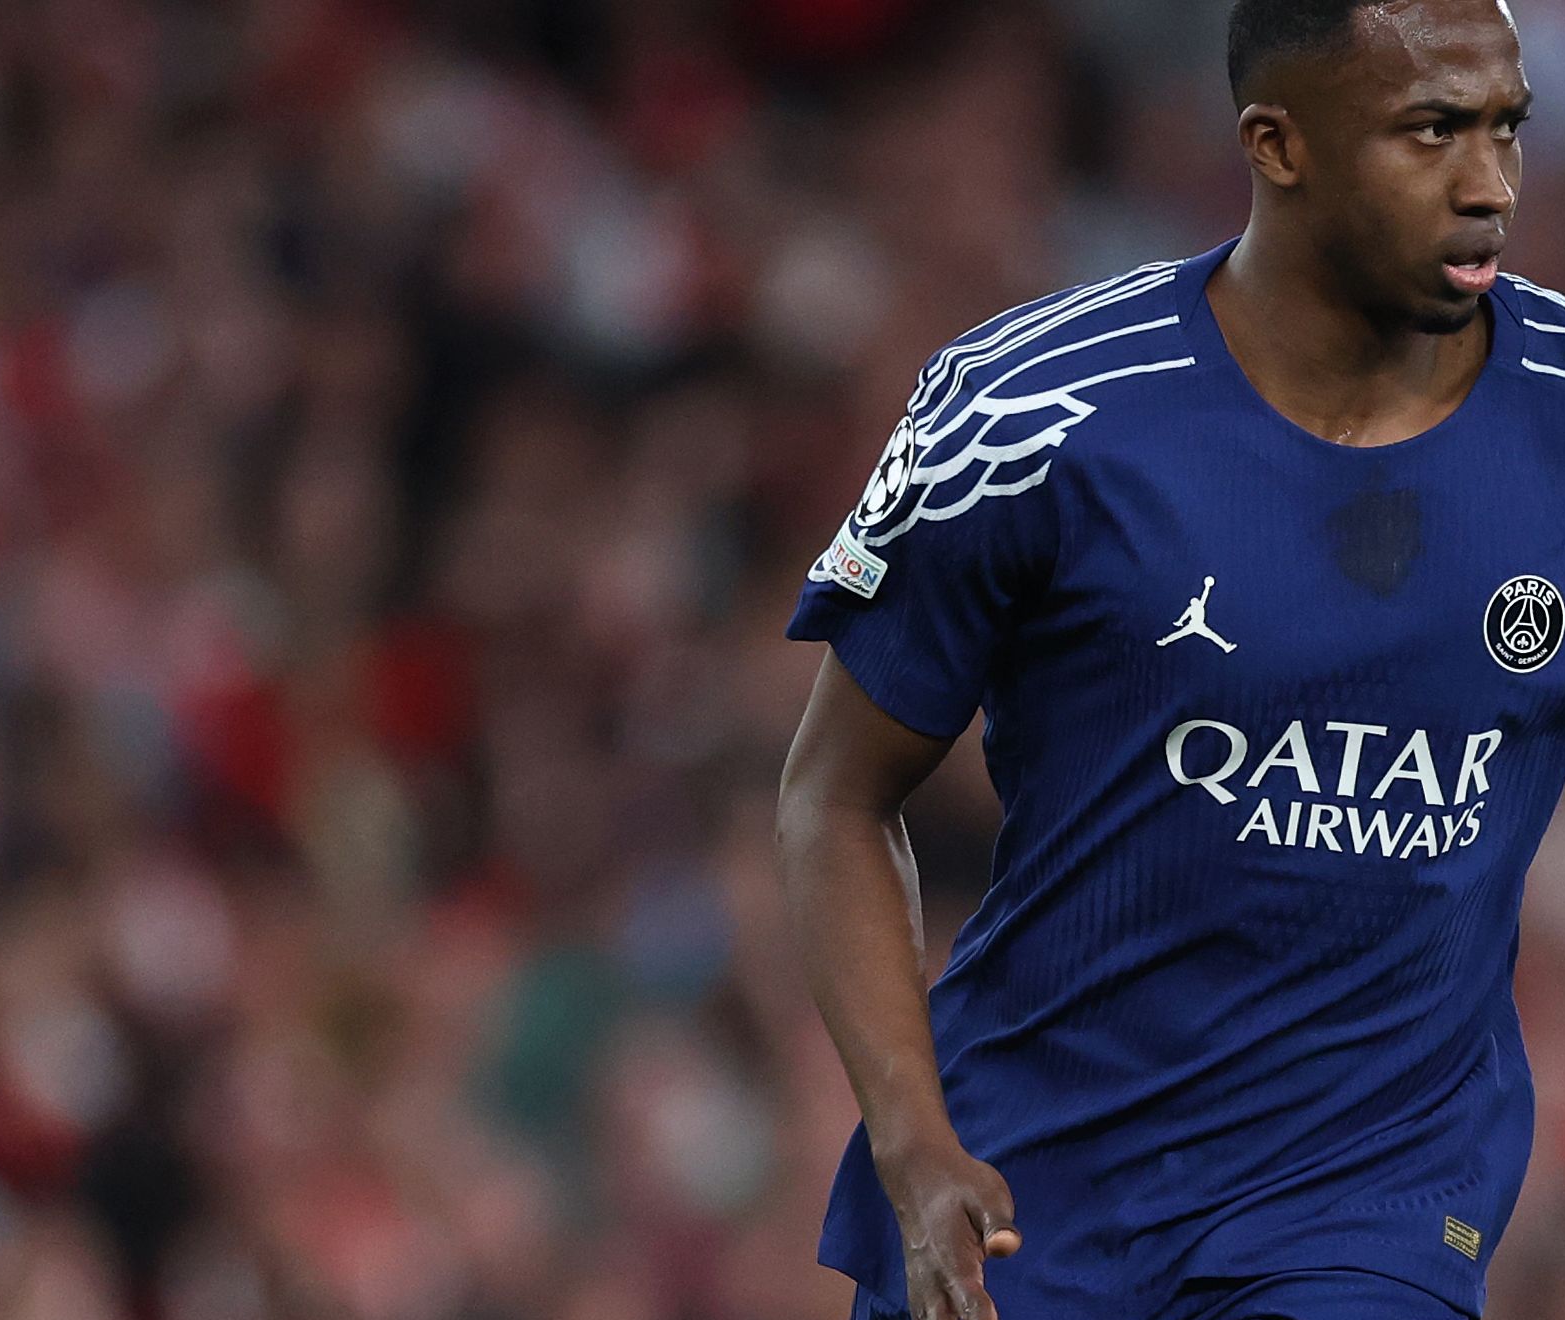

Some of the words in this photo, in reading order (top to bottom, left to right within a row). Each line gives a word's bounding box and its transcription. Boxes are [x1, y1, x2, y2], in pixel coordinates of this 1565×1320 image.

[1501, 580, 1556, 606] PARIS
[1495, 642, 1514, 661] SAINT
[1518, 647, 1548, 665] GERMAIN
[1165, 719, 1503, 806] QATAR
[1236, 798, 1485, 860] AIRWAYS
